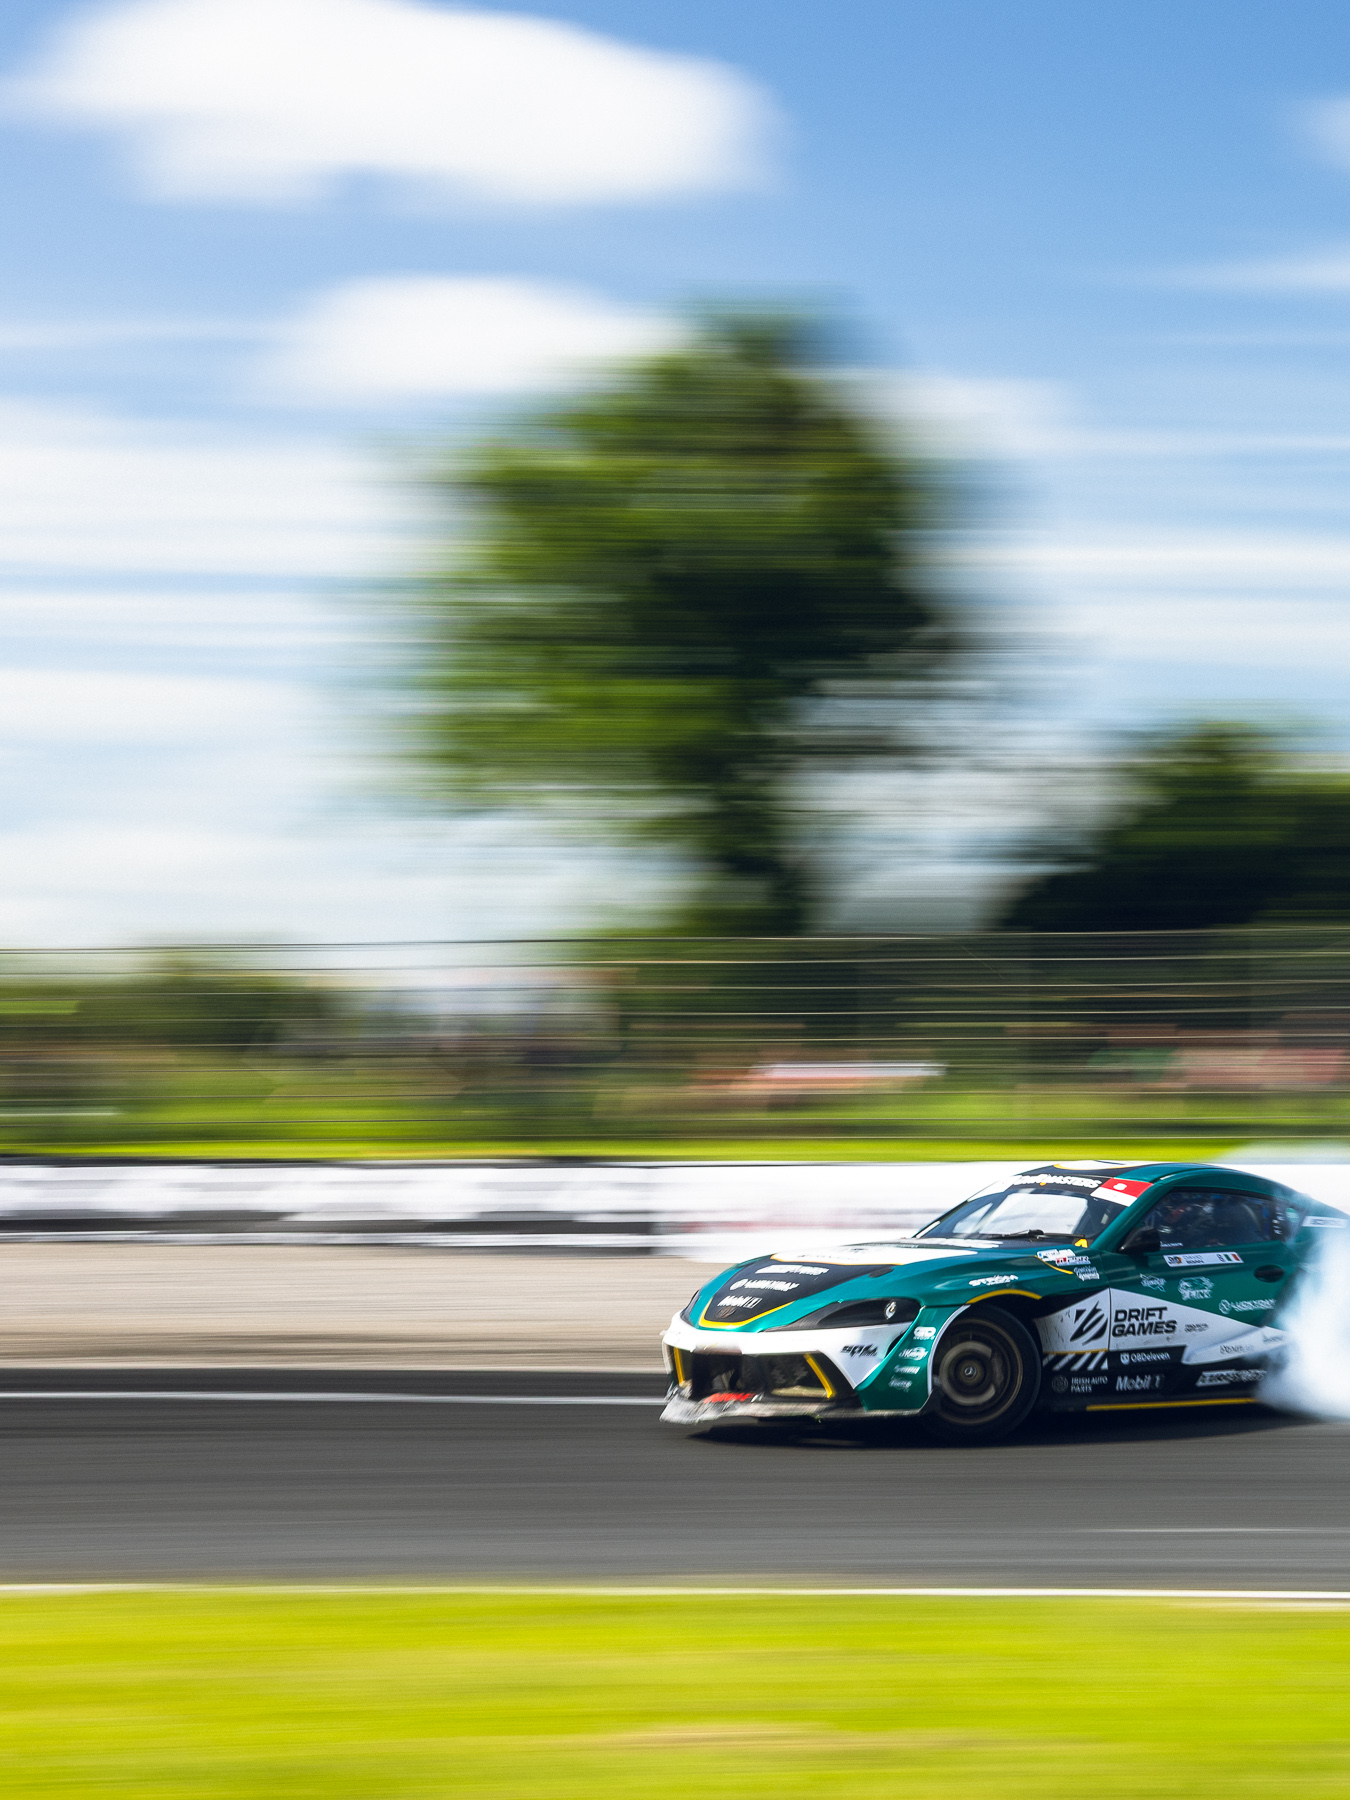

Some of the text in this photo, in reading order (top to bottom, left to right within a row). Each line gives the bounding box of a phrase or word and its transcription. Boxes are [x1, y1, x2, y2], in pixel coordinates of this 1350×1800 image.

[1114, 1306, 1168, 1323] DRIFT
[1112, 1320, 1178, 1338] GAMES
[1130, 1351, 1171, 1363] OBDeleven
[1071, 1375, 1109, 1385] IRISH AUTO
[1115, 1374, 1152, 1392] Mobil
[1070, 1384, 1093, 1393] PARTS
